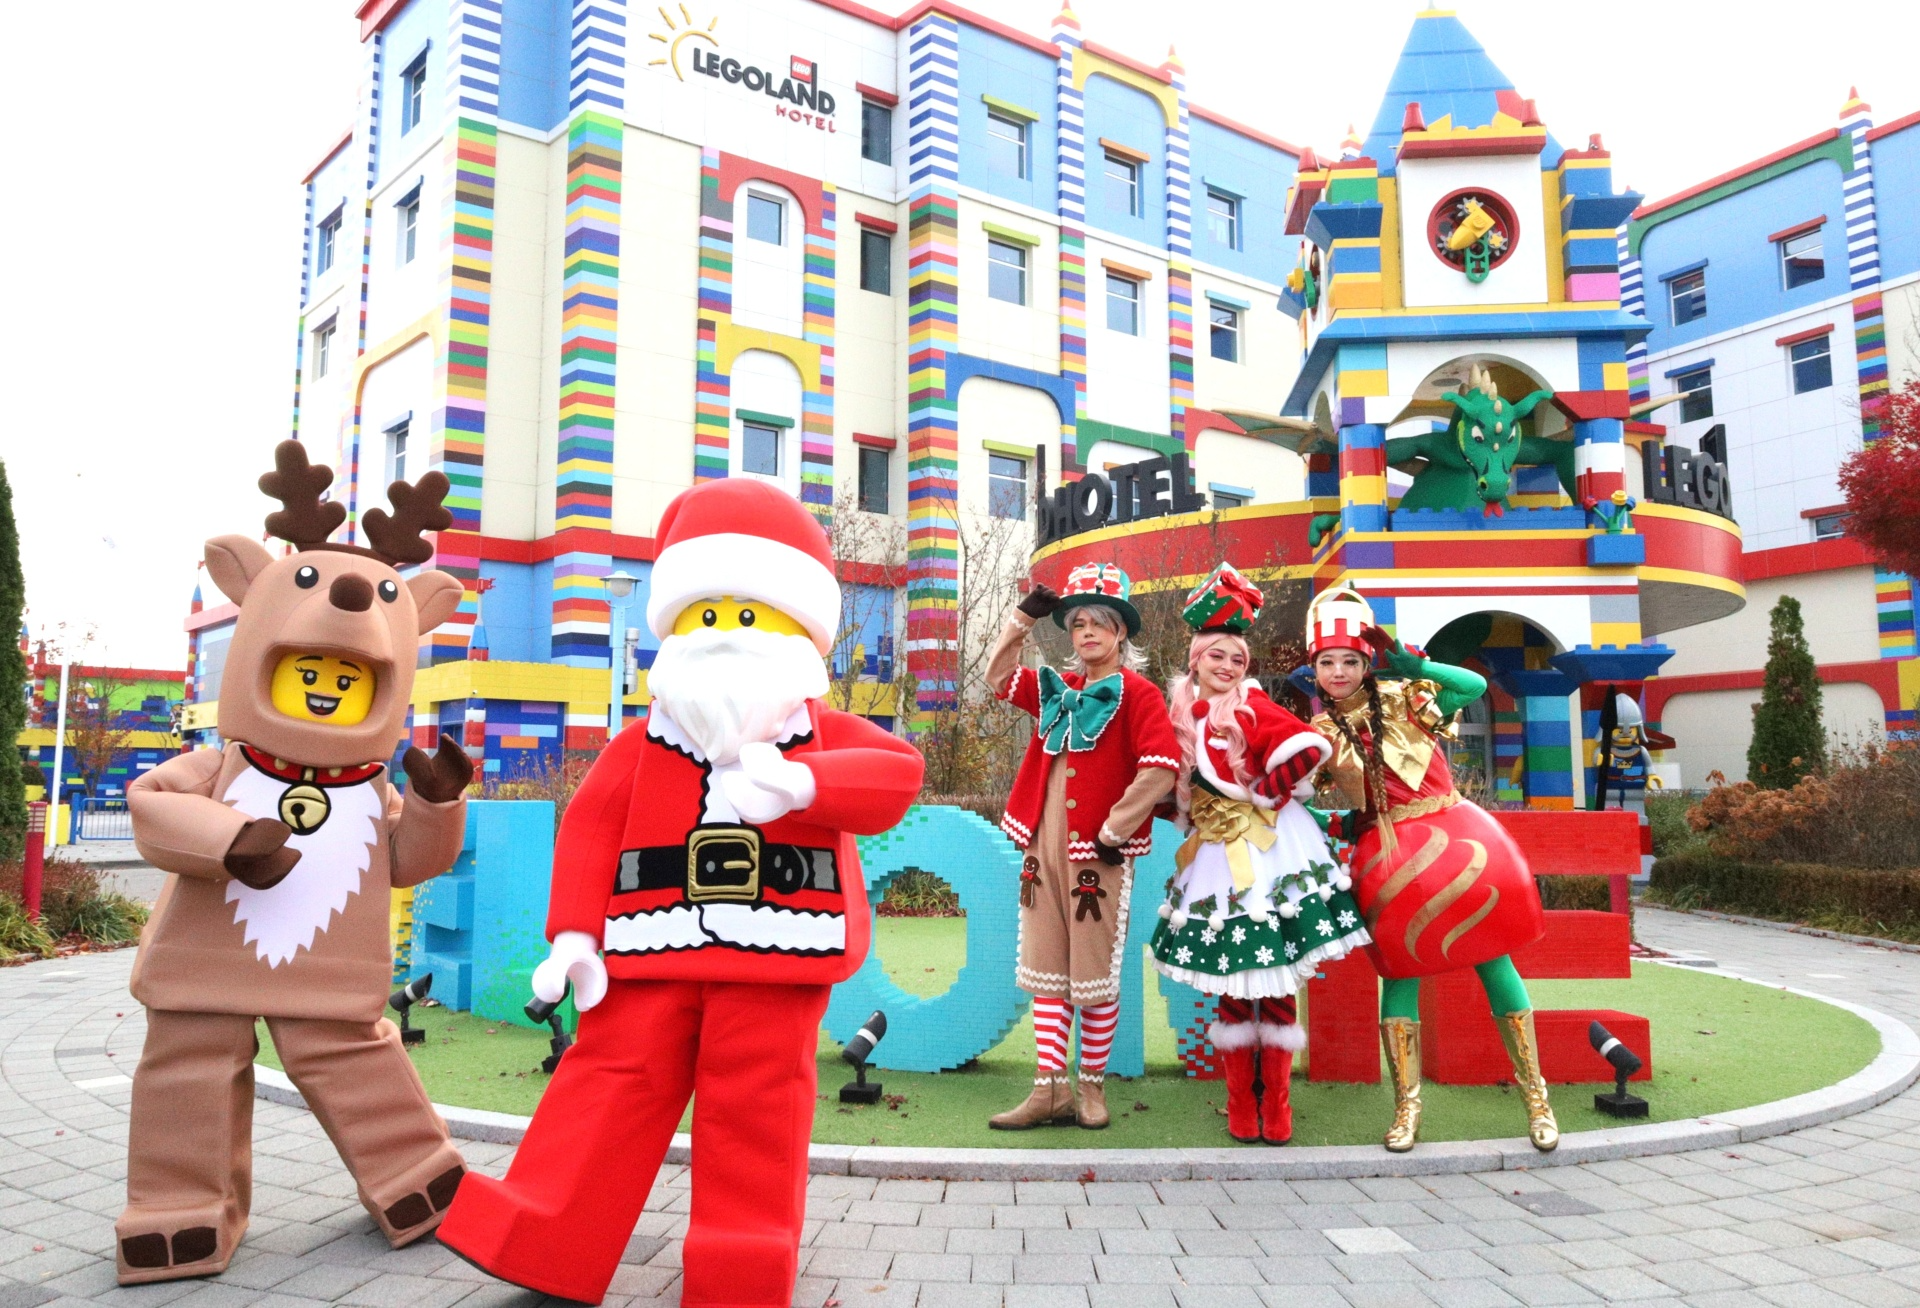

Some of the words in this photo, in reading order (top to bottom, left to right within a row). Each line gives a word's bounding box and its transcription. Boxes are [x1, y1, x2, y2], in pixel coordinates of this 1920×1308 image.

[693, 47, 836, 115] LEGOLAND
[776, 104, 837, 133] HOTEL
[1054, 452, 1206, 538] HOTEL
